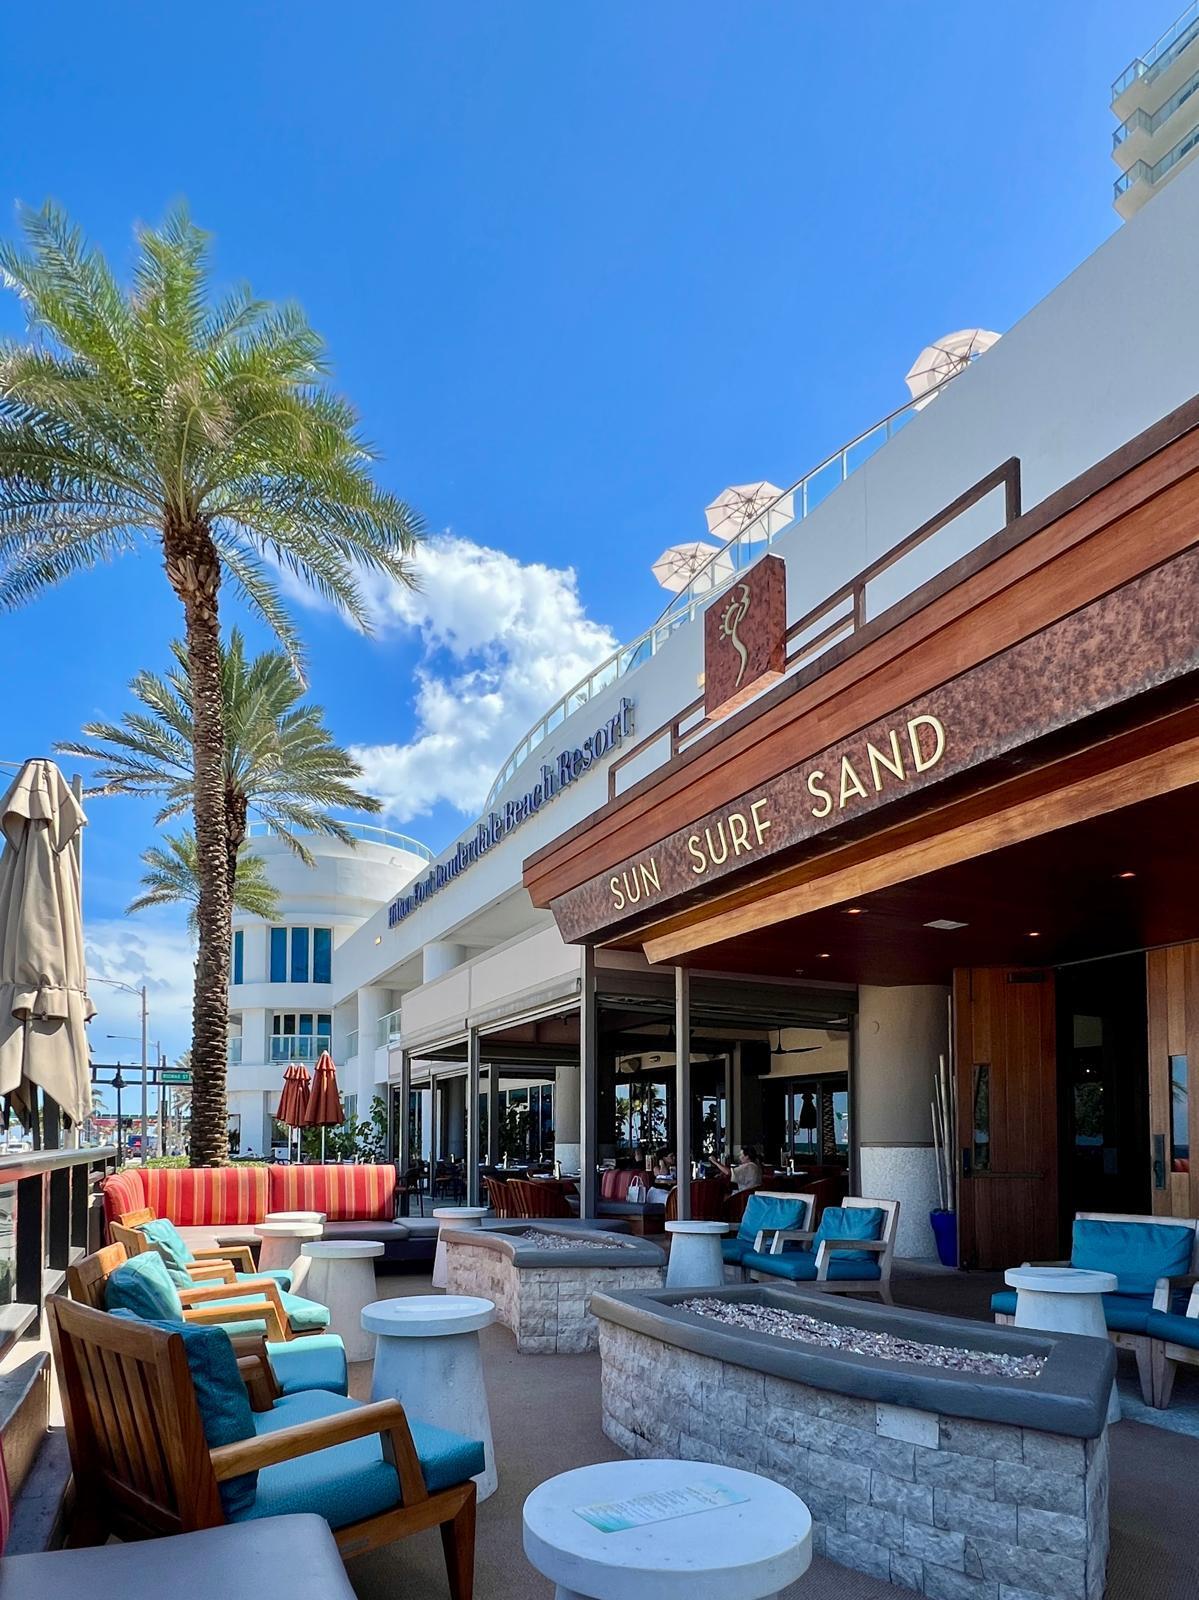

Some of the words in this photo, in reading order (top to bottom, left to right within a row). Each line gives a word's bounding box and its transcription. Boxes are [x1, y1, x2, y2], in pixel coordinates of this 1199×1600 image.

[503, 764, 555, 834] Beach
[556, 697, 634, 790] Resort
[609, 857, 662, 910] SUN
[687, 797, 772, 874] SURF
[806, 714, 946, 818] SAND
